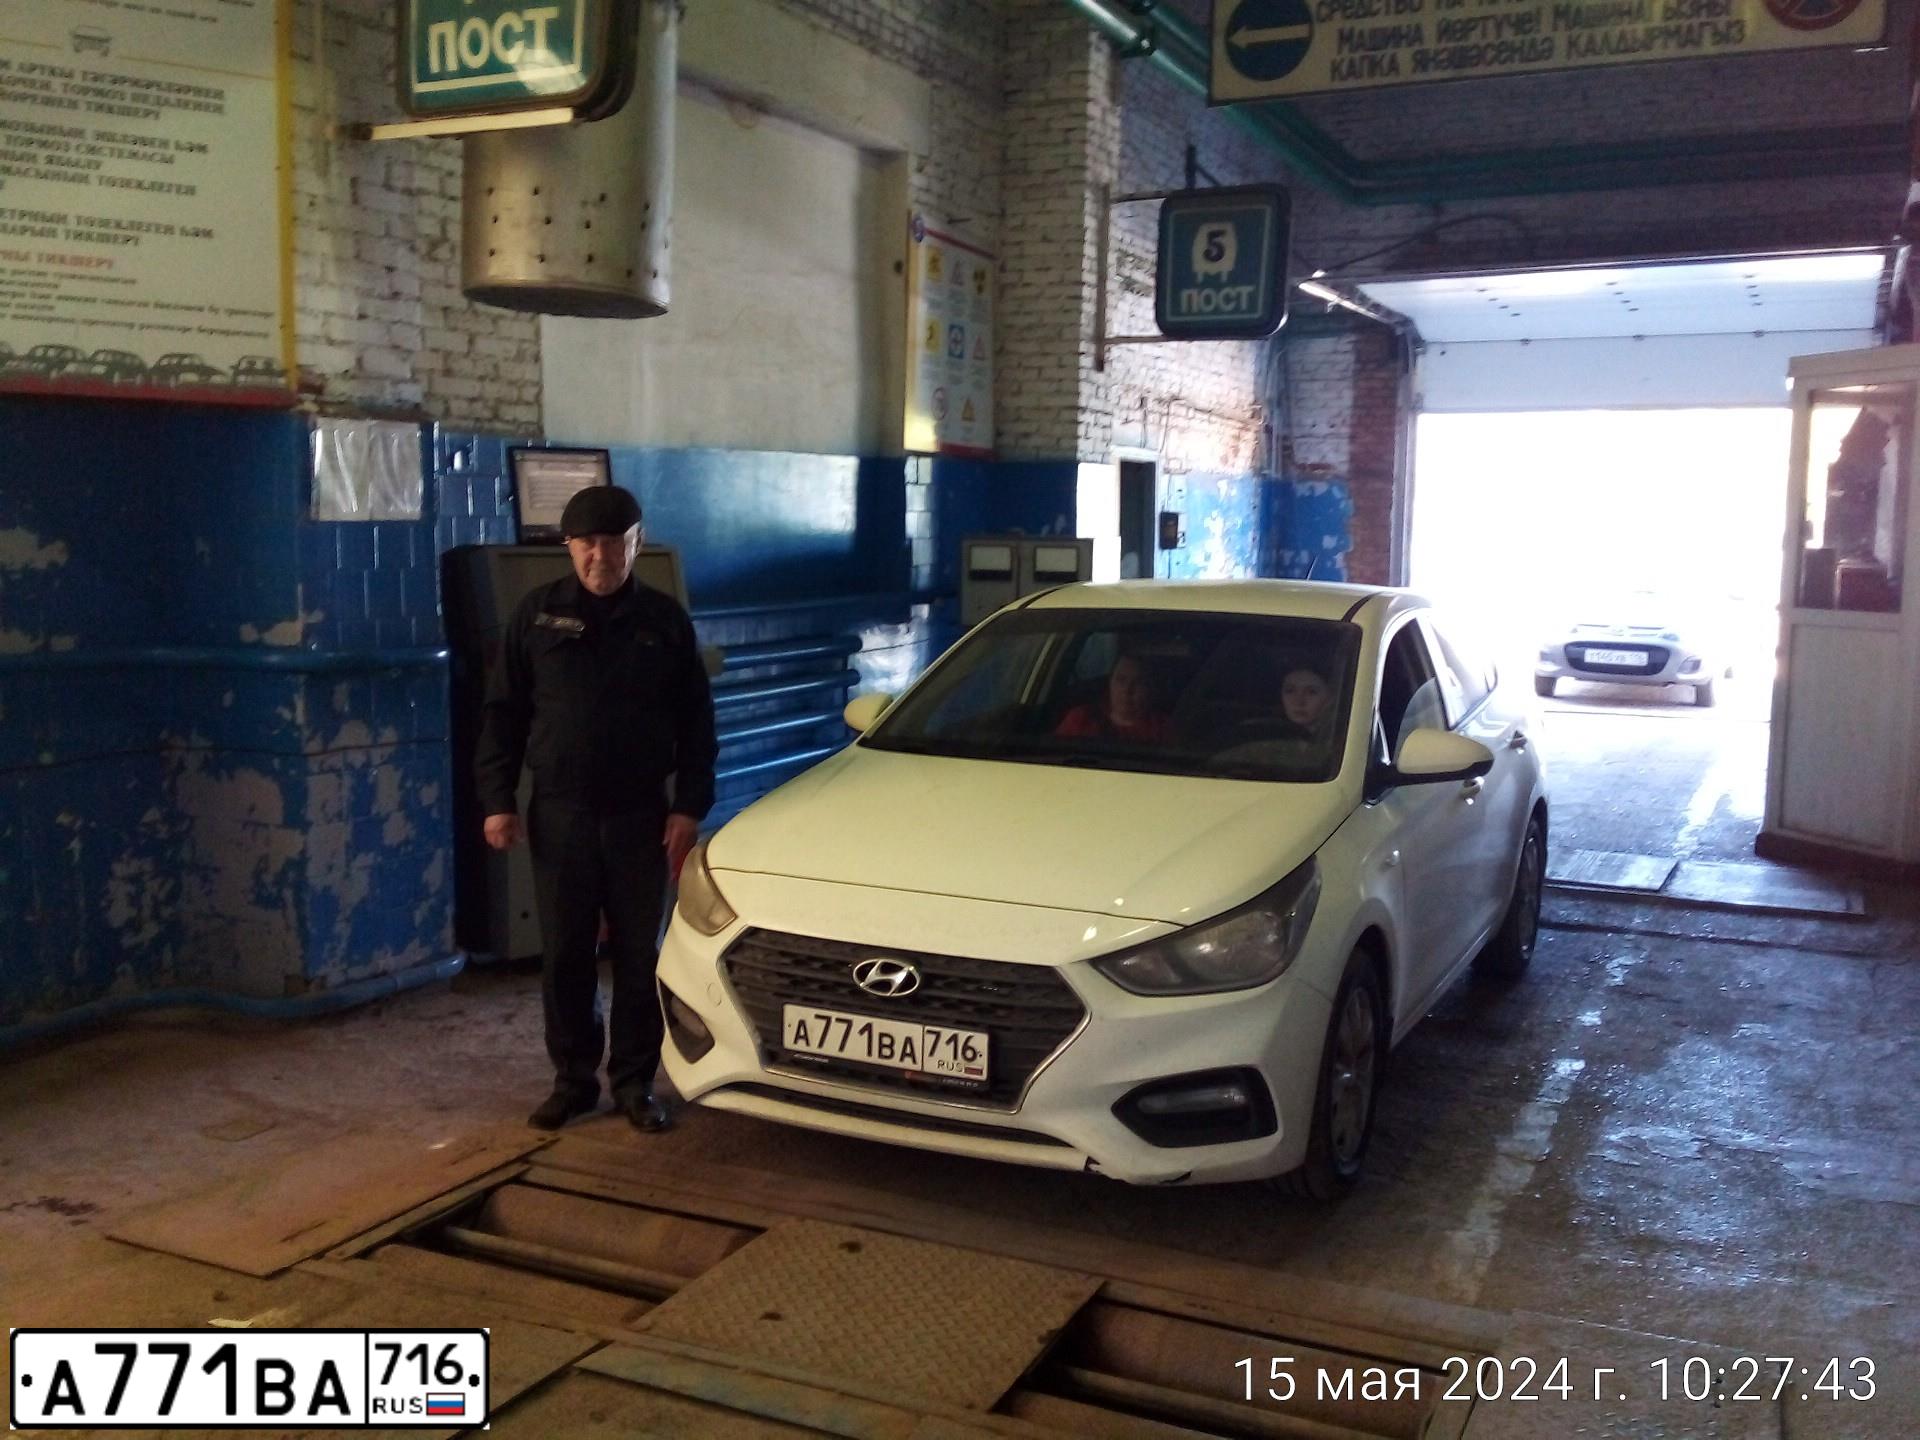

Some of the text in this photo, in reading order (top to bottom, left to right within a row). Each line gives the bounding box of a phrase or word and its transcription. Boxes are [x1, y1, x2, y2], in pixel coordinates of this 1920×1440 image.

[428, 6, 560, 74] ПОСТ
[1330, 51, 1400, 82] КАПКА
[1203, 229, 1227, 262] 5
[1180, 285, 1256, 313] ПОСТ
[925, 1029, 978, 1063] 716
[937, 1059, 963, 1073] RUS
